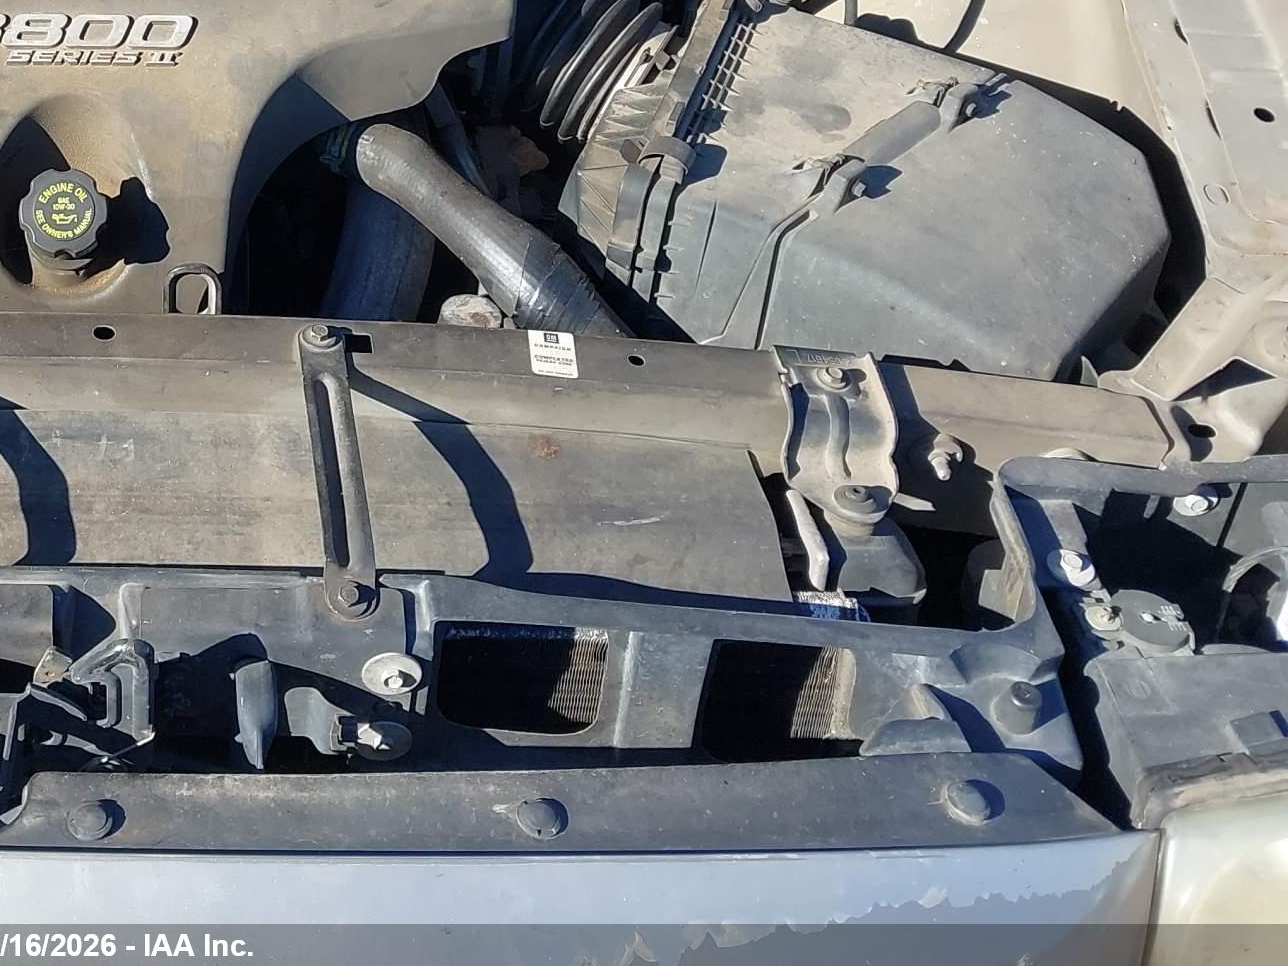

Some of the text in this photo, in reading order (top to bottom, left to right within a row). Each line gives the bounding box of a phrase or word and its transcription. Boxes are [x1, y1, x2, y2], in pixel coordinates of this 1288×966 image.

[6, 49, 144, 67] SERIES
[38, 182, 88, 203] ENGINE OIL
[57, 196, 70, 204] SAE
[52, 203, 76, 211] 10W-30
[35, 209, 47, 225] SEE
[73, 207, 93, 235] MANUAL
